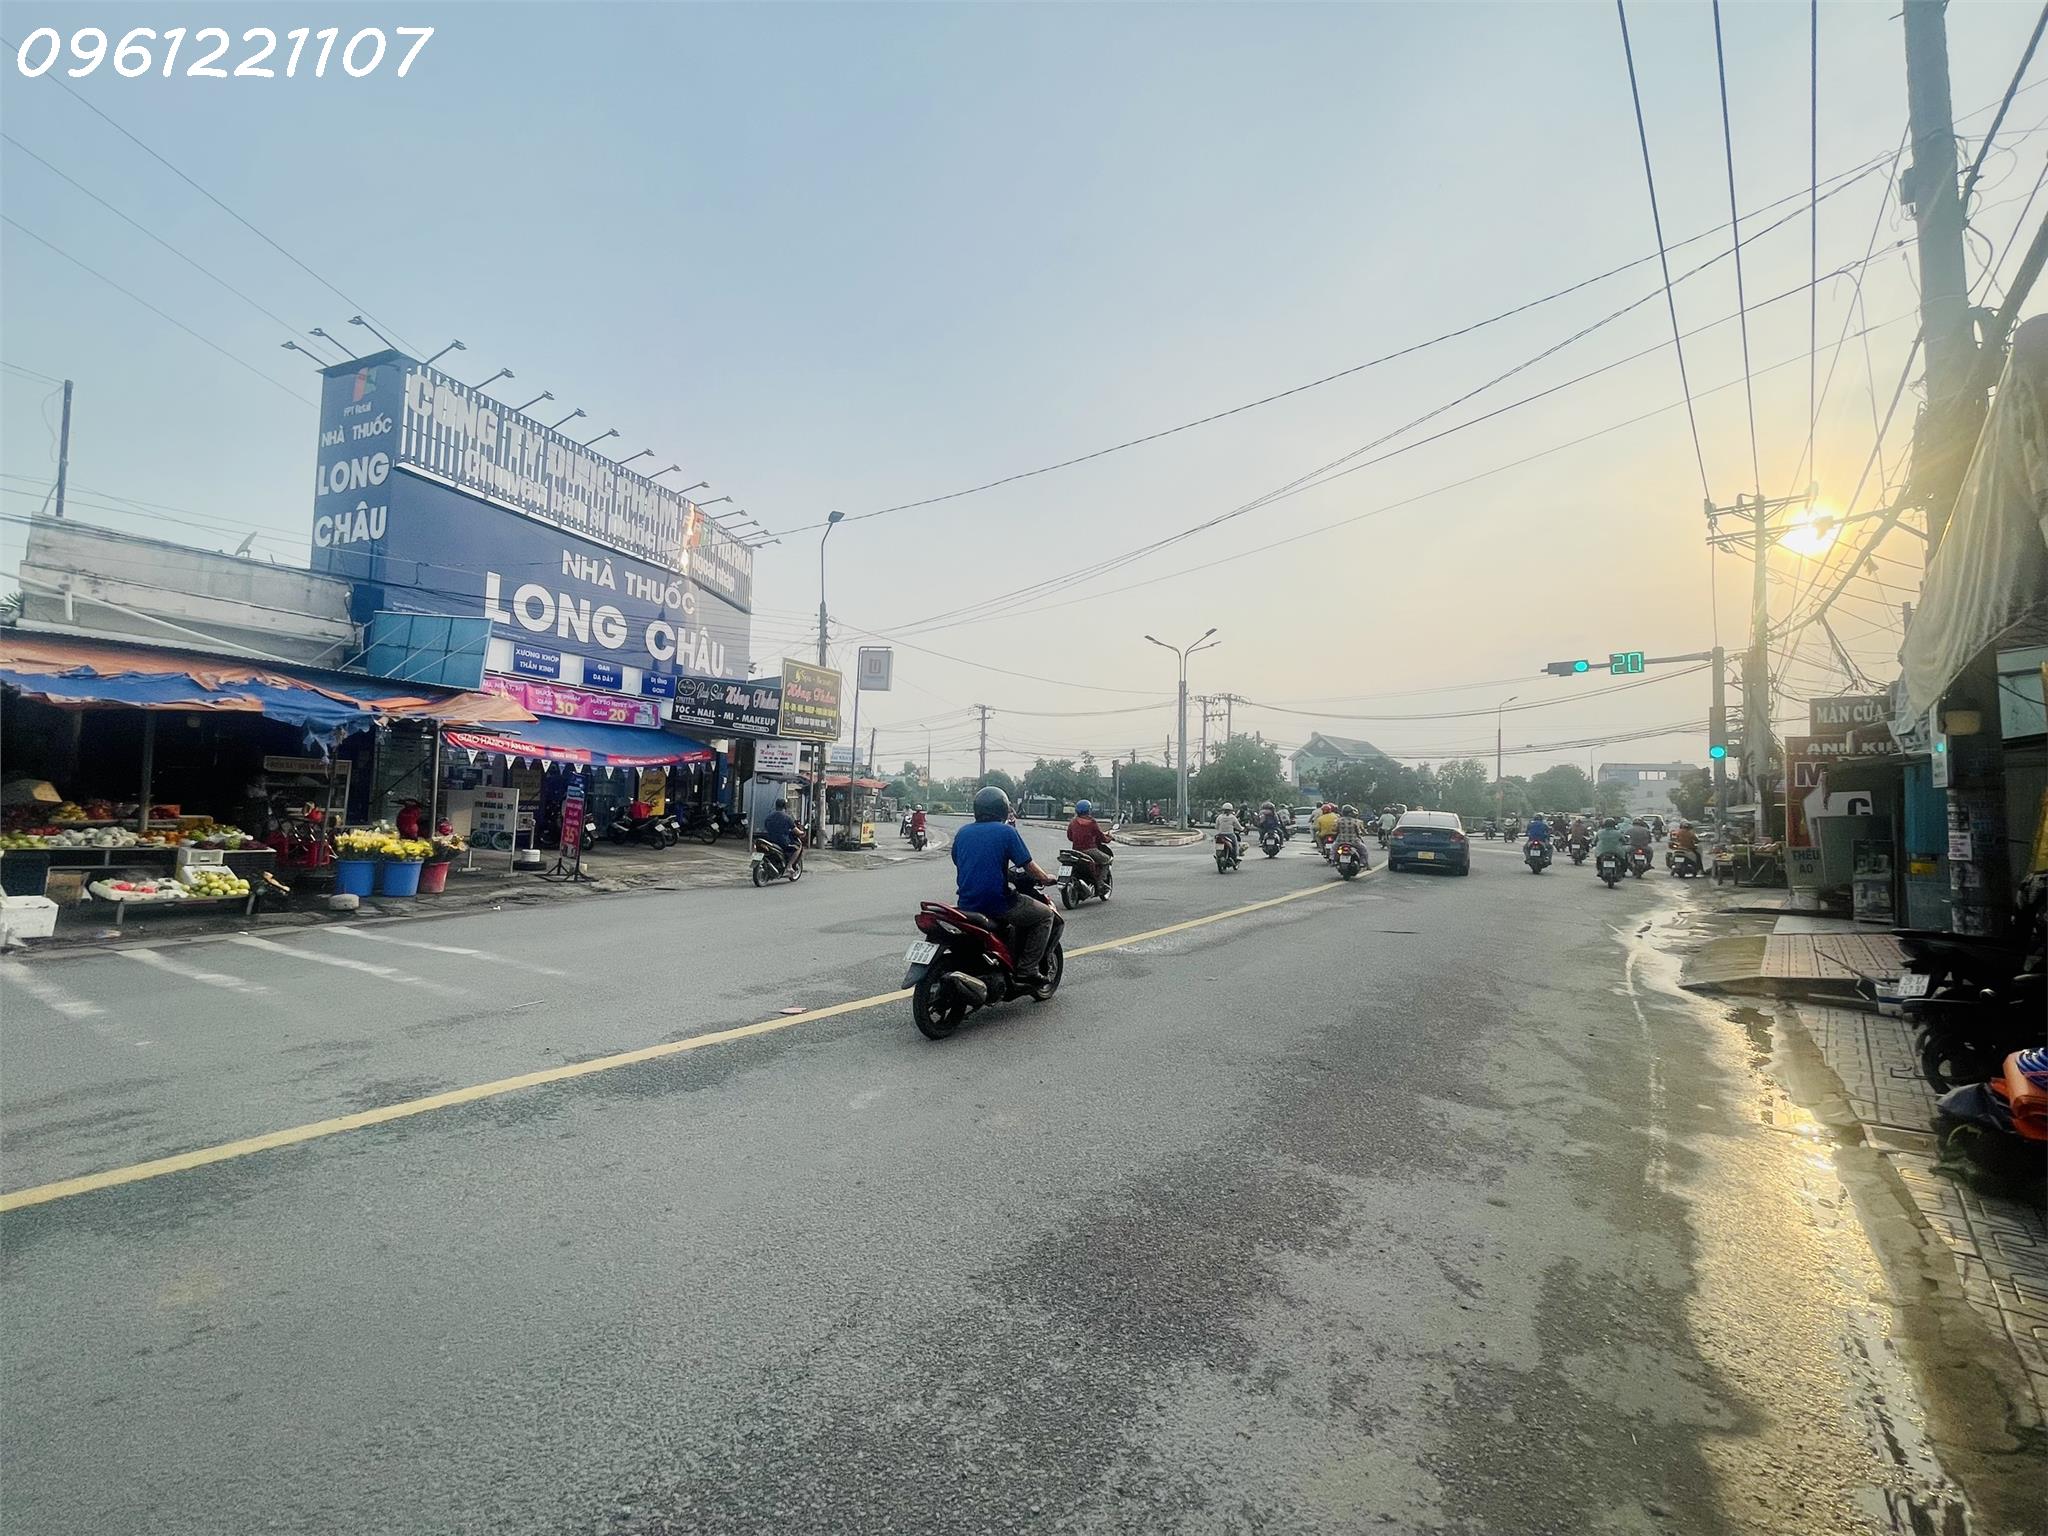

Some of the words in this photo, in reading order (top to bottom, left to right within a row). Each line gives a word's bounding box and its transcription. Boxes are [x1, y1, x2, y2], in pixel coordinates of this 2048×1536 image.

[322, 425, 345, 447] NHÀ
[352, 412, 393, 441] THUỐC
[318, 452, 390, 497] LONG
[314, 501, 387, 547] CHÂU
[562, 549, 616, 591] NHÀ
[624, 571, 696, 615] THUỐC
[485, 571, 628, 649] LONG
[645, 620, 726, 678] CHÂU
[1611, 652, 1643, 674] 20
[675, 704, 690, 714] TÓC
[697, 708, 715, 718] NAIL
[723, 711, 734, 720] MI
[742, 714, 776, 726] MAKEUP
[1816, 701, 1850, 723] MÀN
[1853, 698, 1884, 721] CỬA
